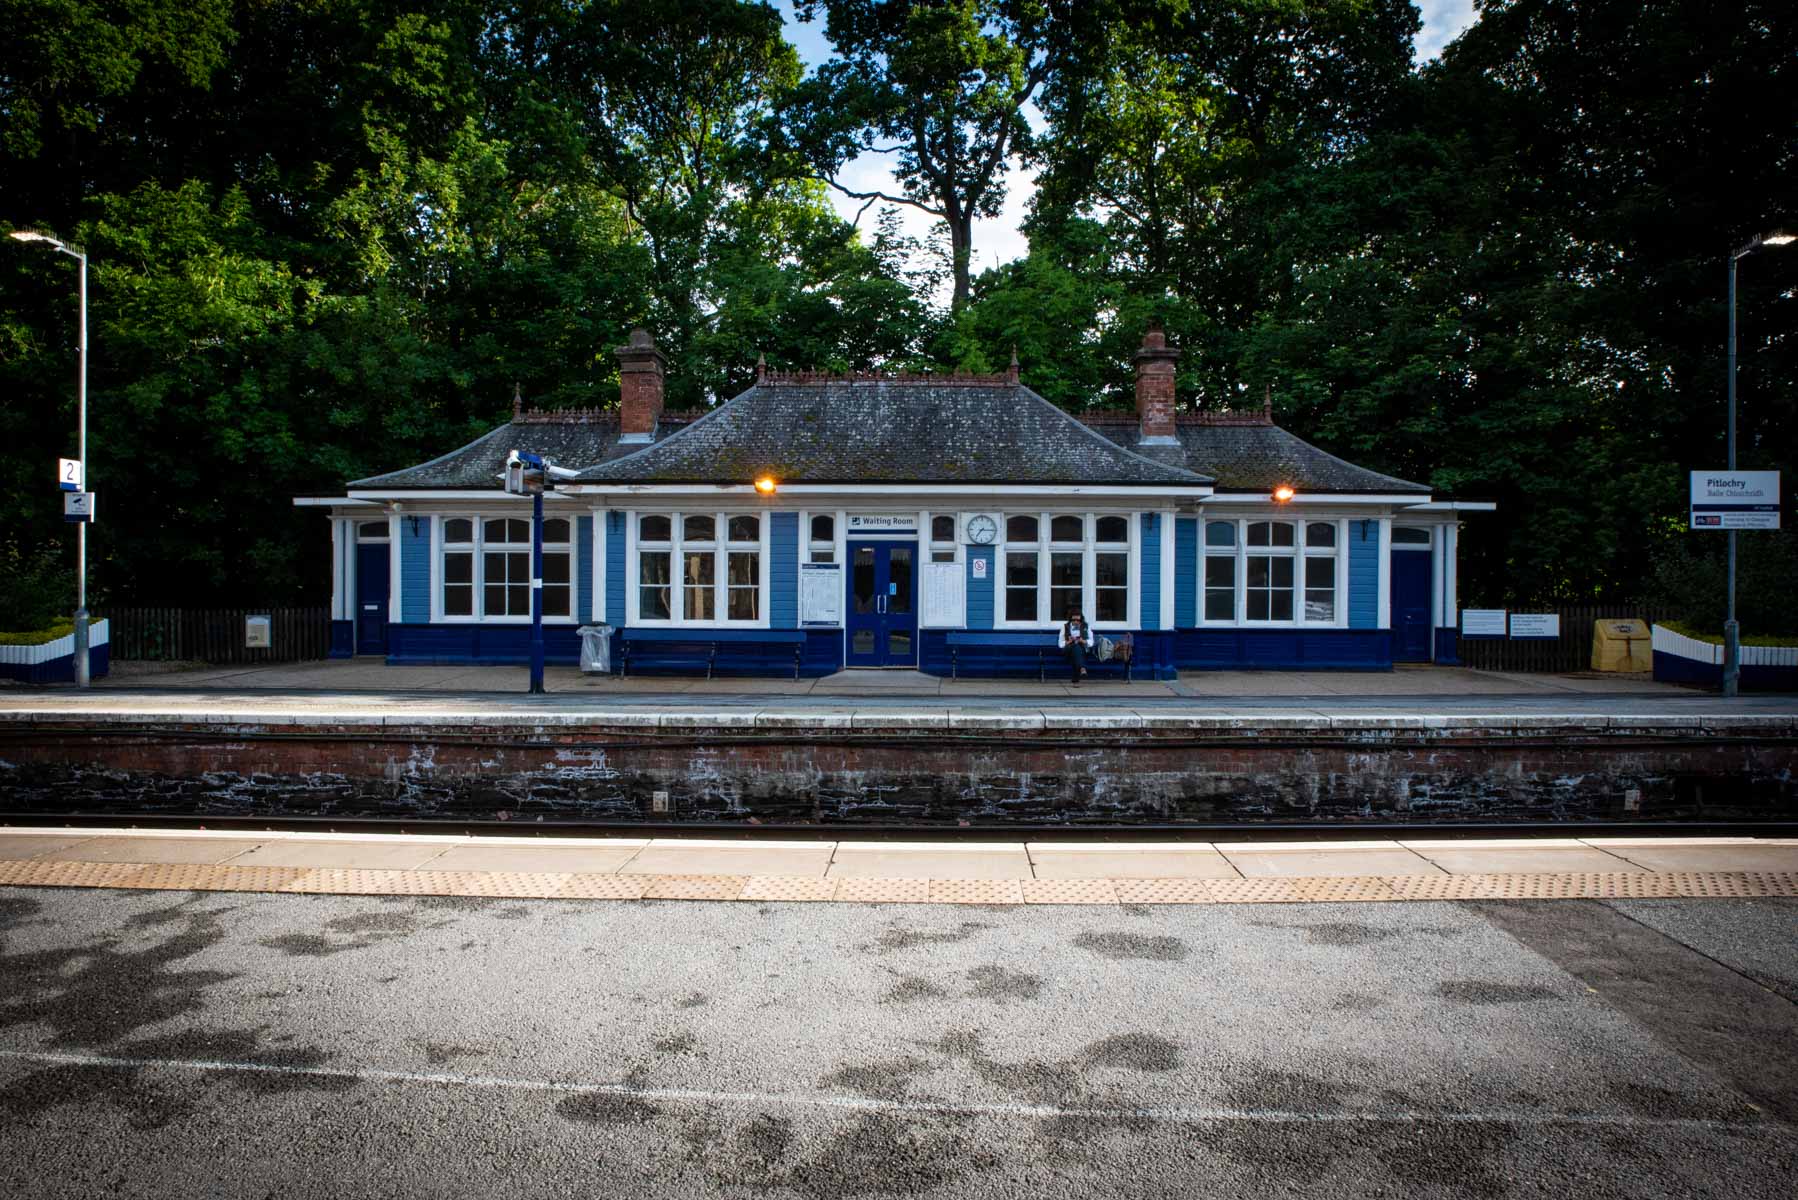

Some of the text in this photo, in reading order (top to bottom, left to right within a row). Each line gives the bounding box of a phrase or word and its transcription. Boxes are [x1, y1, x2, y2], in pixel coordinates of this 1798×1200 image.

[67, 462, 73, 480] 2
[1707, 479, 1746, 489] Pitlochry
[863, 517, 913, 526] Waiting Room
